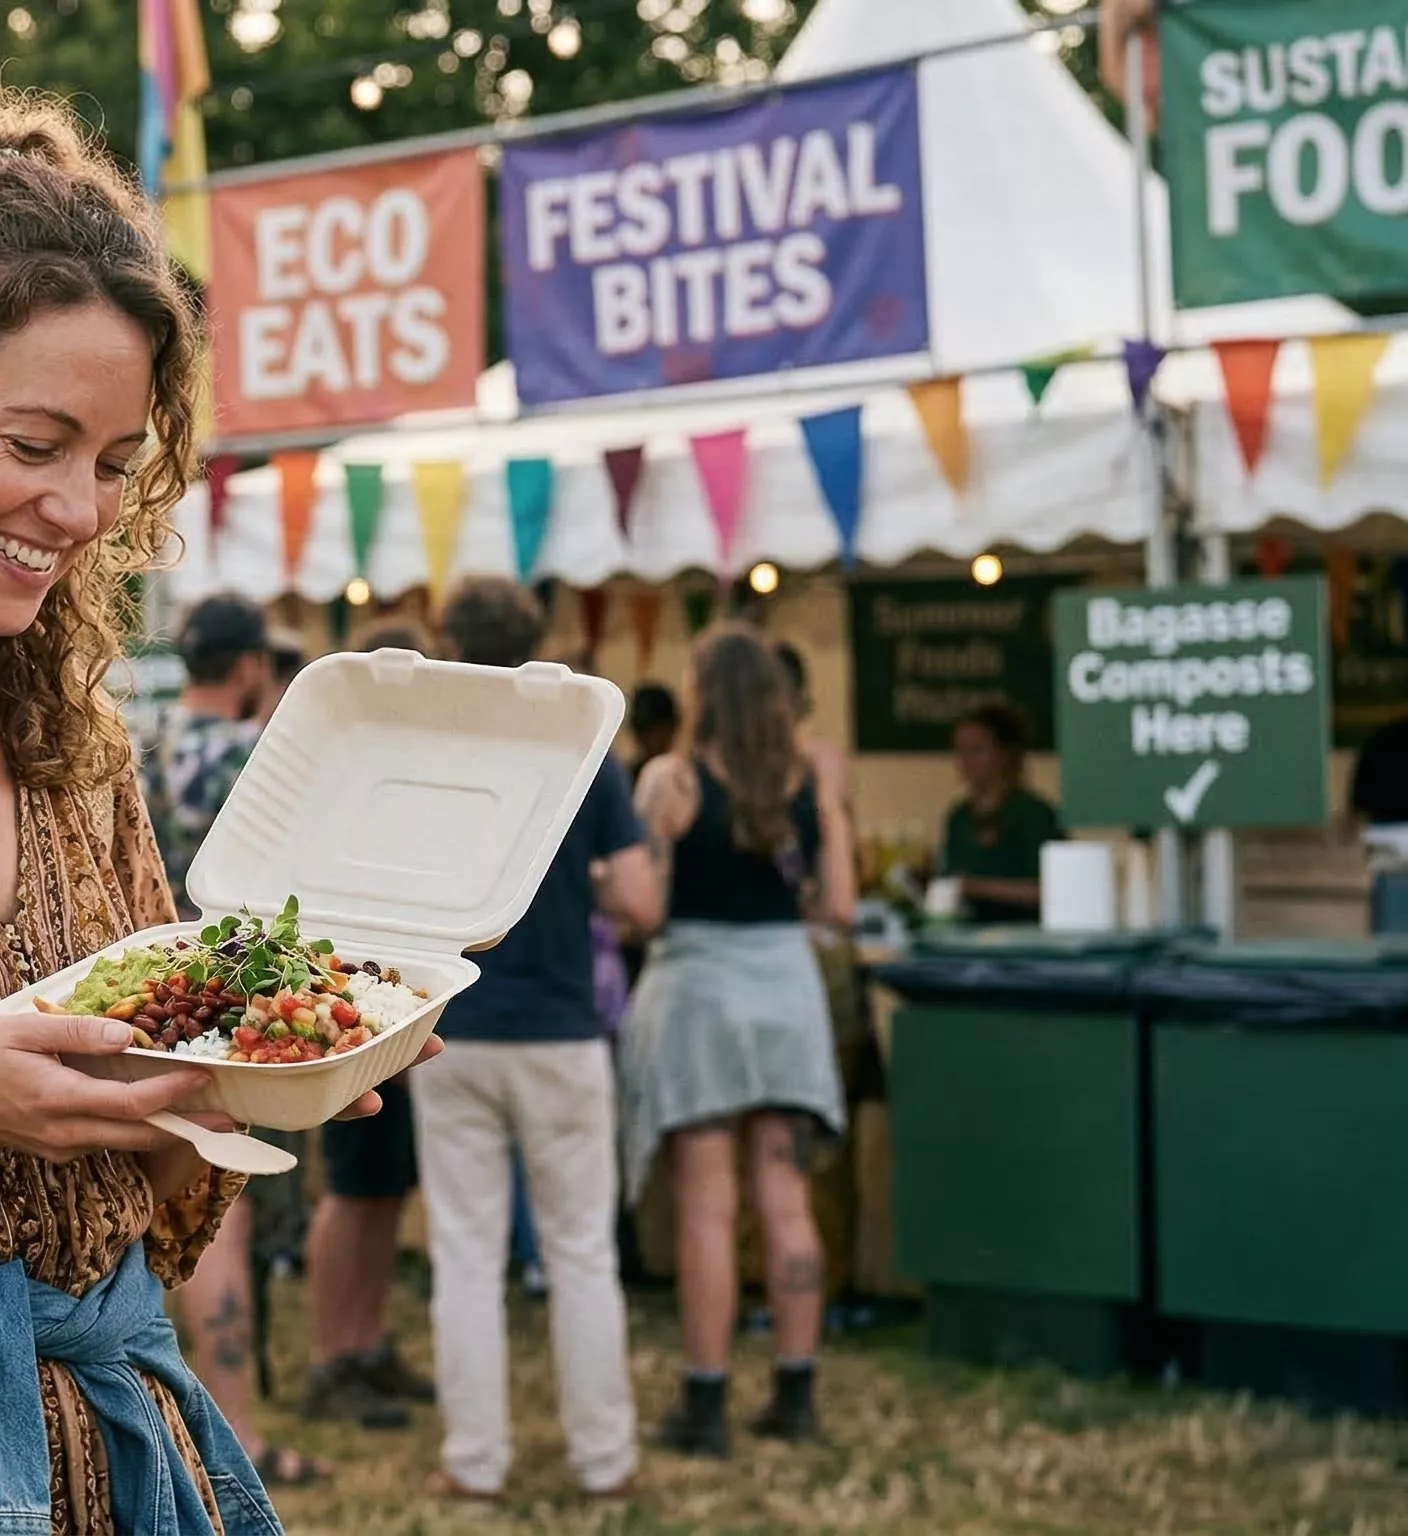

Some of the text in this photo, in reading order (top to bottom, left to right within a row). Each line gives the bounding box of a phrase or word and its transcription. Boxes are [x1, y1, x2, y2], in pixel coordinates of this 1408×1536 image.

[1200, 22, 1408, 118] SUSTA
[525, 122, 901, 271] FESTIVAL
[1205, 99, 1408, 237] FOO
[255, 188, 429, 301] ECO
[592, 232, 832, 355] BITES
[238, 286, 450, 399] EATS
[1068, 648, 1313, 706] Composts
[1087, 597, 1291, 655] Bagasse
[1131, 704, 1250, 754] Here
